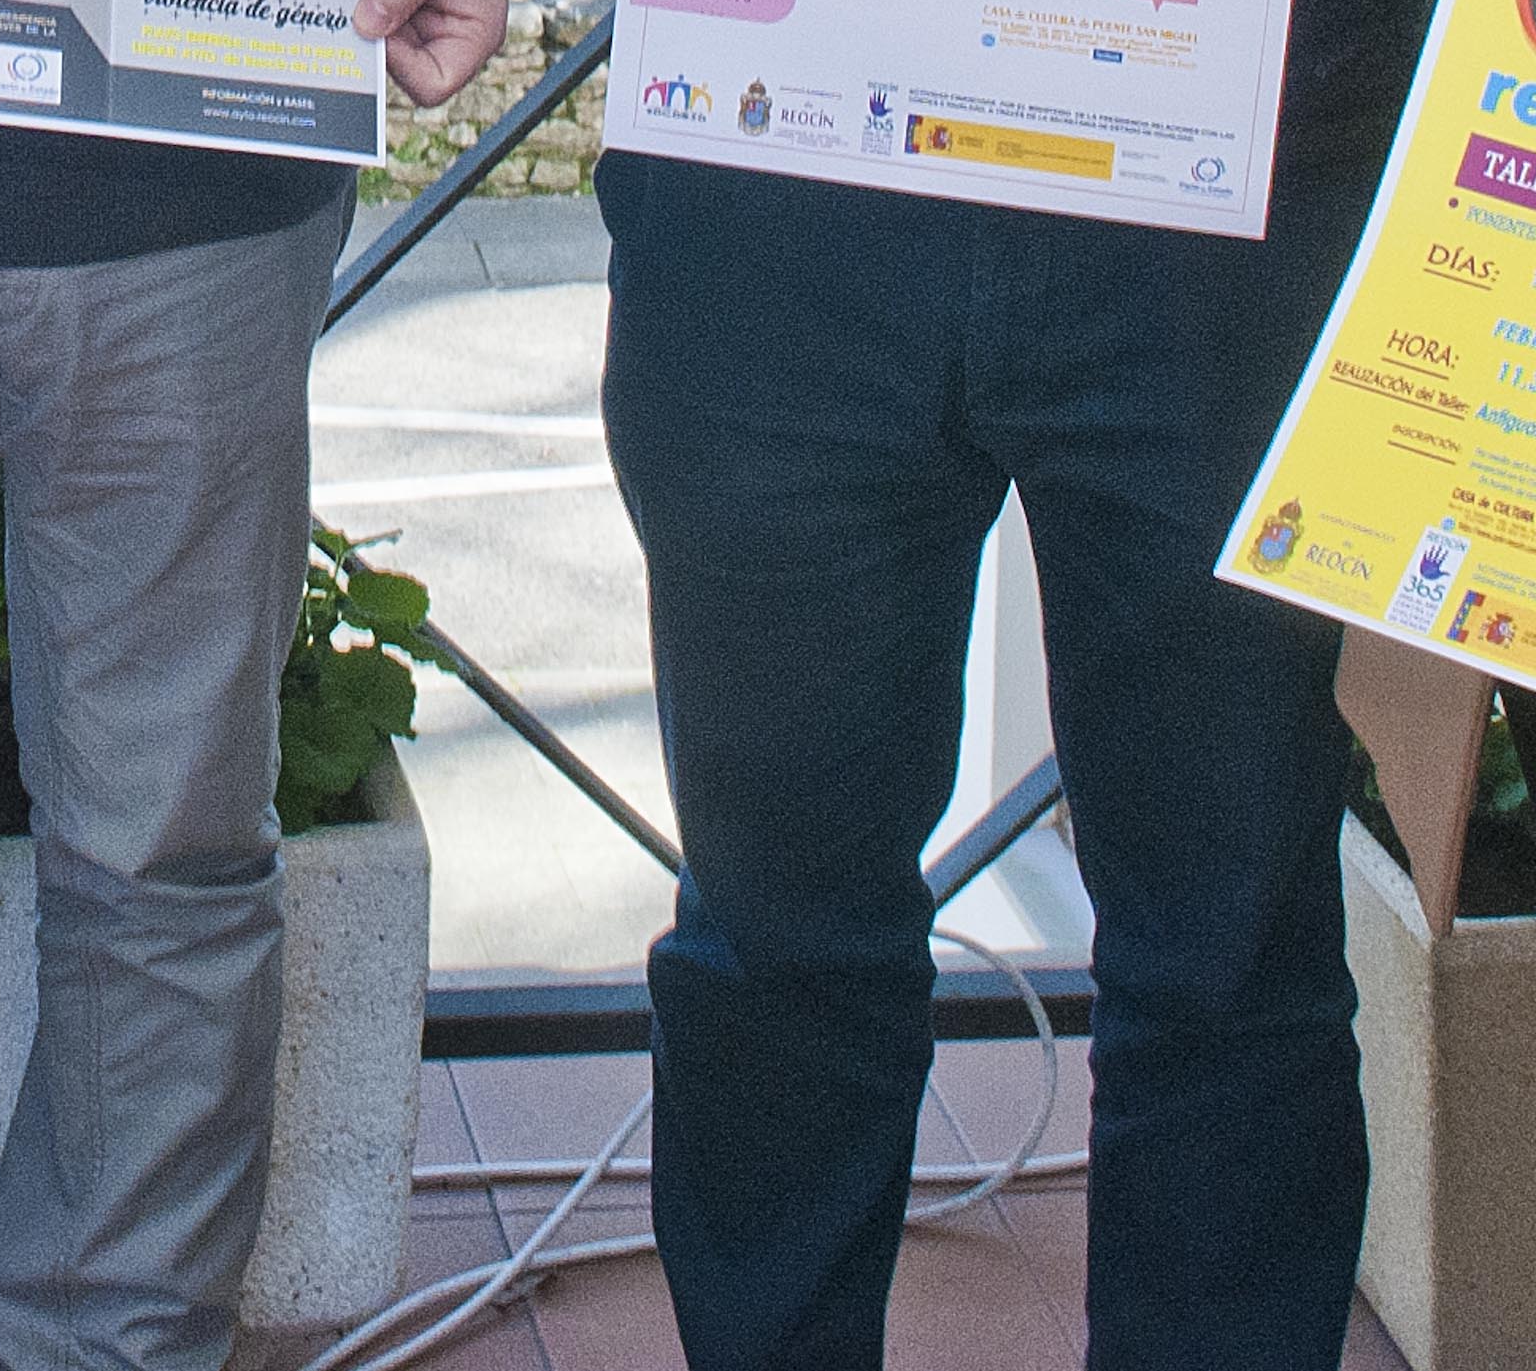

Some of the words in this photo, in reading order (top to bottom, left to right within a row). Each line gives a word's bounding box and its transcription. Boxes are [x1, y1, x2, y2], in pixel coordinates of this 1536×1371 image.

[275, 1, 348, 37] género
[1427, 243, 1499, 281] DÍAS:
[1386, 329, 1459, 368] HORA:
